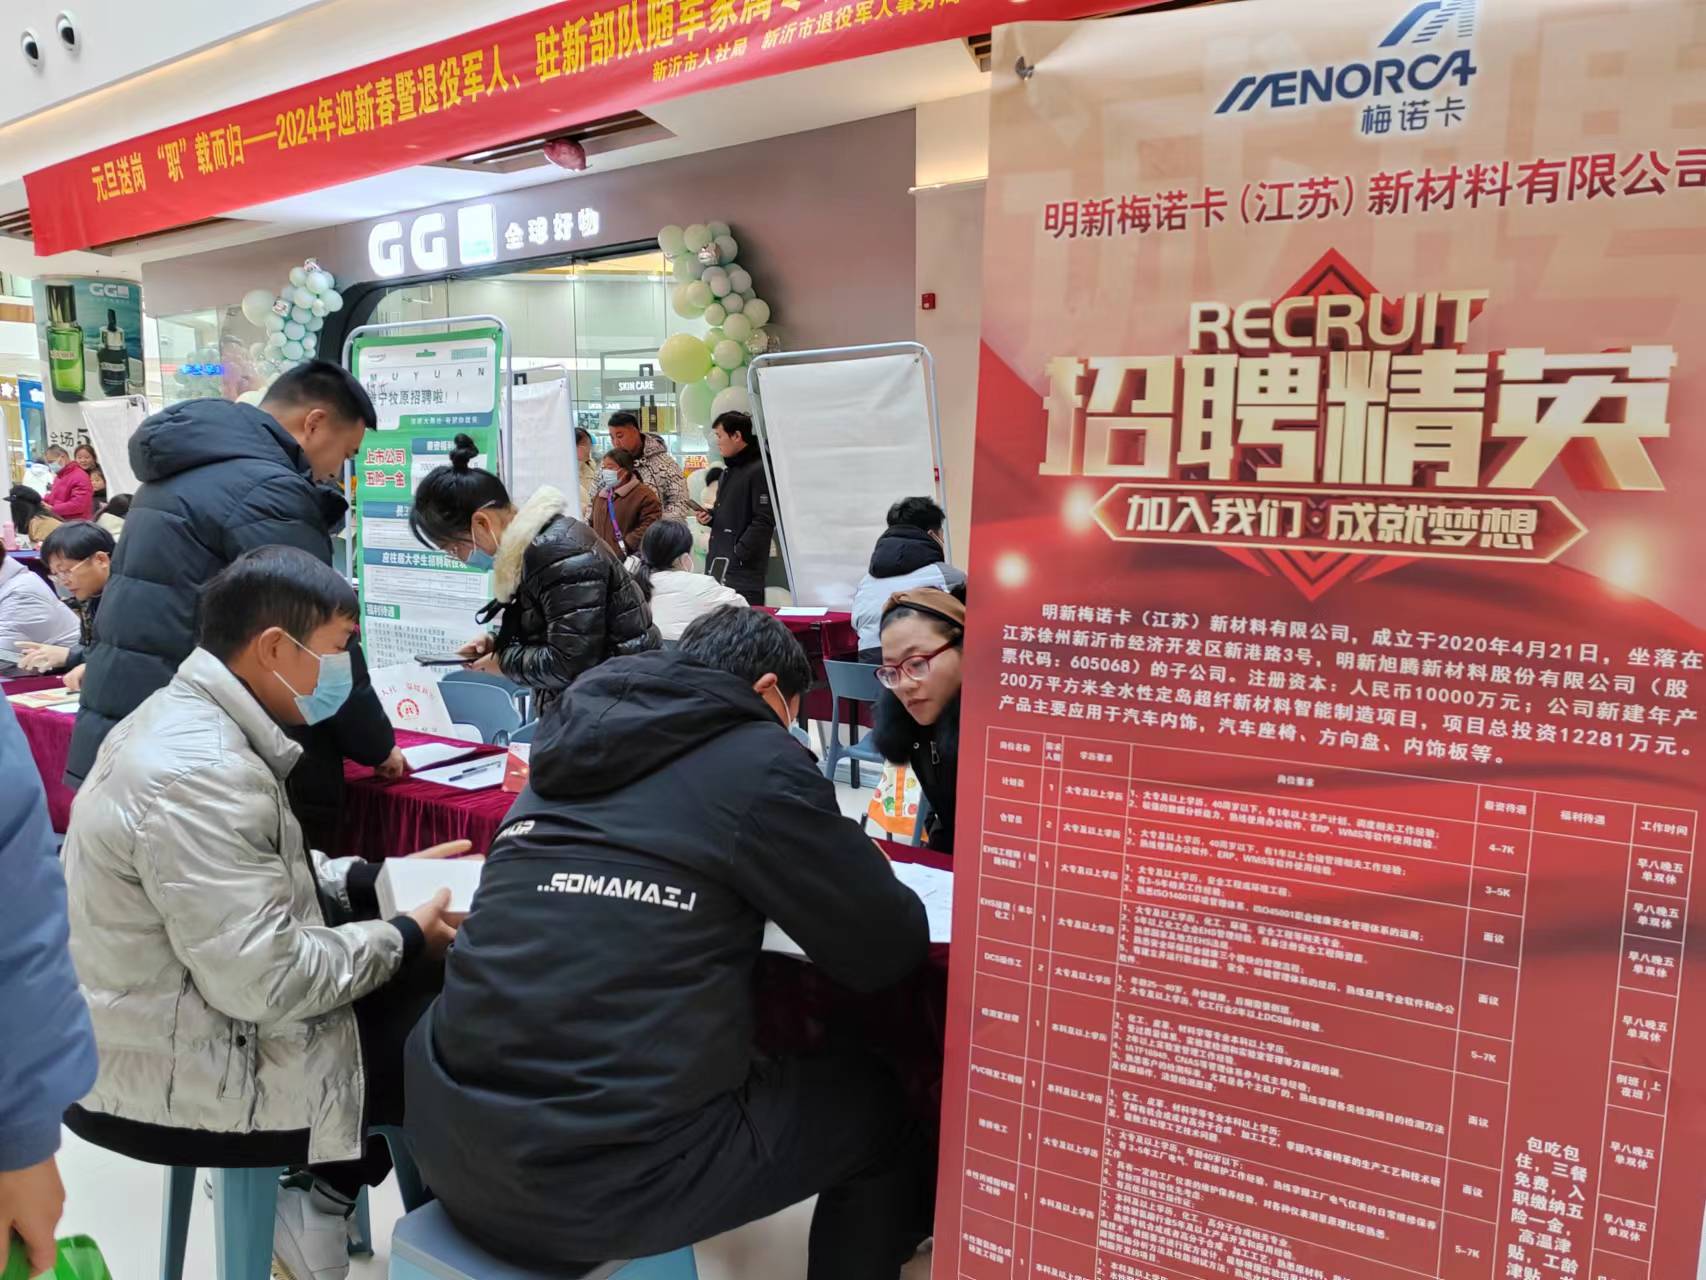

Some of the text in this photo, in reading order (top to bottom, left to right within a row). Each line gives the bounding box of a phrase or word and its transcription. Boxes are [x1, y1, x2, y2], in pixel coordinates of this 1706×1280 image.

[652, 37, 748, 82] 新沂市人社局
[1215, 49, 1477, 115] MENORCA
[1361, 97, 1467, 136] 梅诺卡
[91, 151, 147, 203] 元旦送岗
[505, 207, 600, 250] 全球好物
[1189, 289, 1490, 350] RECRUIT
[618, 380, 654, 391] SKIN CARE
[1038, 345, 1679, 492] 招聘精英
[366, 449, 405, 464] 上市公司
[366, 472, 405, 486] 五险一金
[1065, 785, 1123, 801] 大专及以上学历
[1560, 810, 1606, 826] 福利待遇
[1063, 823, 1121, 839] 大专及以上学历
[1641, 820, 1689, 837] 工作时间
[1636, 858, 1684, 875] 早八晚五
[1641, 871, 1678, 886] 单双休
[1632, 902, 1680, 919] 早八晚五
[1637, 915, 1673, 930] 单双休
[1628, 950, 1675, 968] 早八晚五
[1632, 963, 1669, 979] 单双休
[1622, 1014, 1669, 1034] 早八晚五
[1626, 1027, 1662, 1043] 单双休
[1527, 1137, 1580, 1163] 包吃包
[1610, 1141, 1655, 1160] 早八晚五
[1614, 1153, 1649, 1170] 单双休
[1512, 1189, 1584, 1220] 职缴纳五
[1603, 1213, 1649, 1232] 早八晚五
[1518, 1228, 1572, 1254] 高温津
[1607, 1225, 1641, 1242] 单双休
